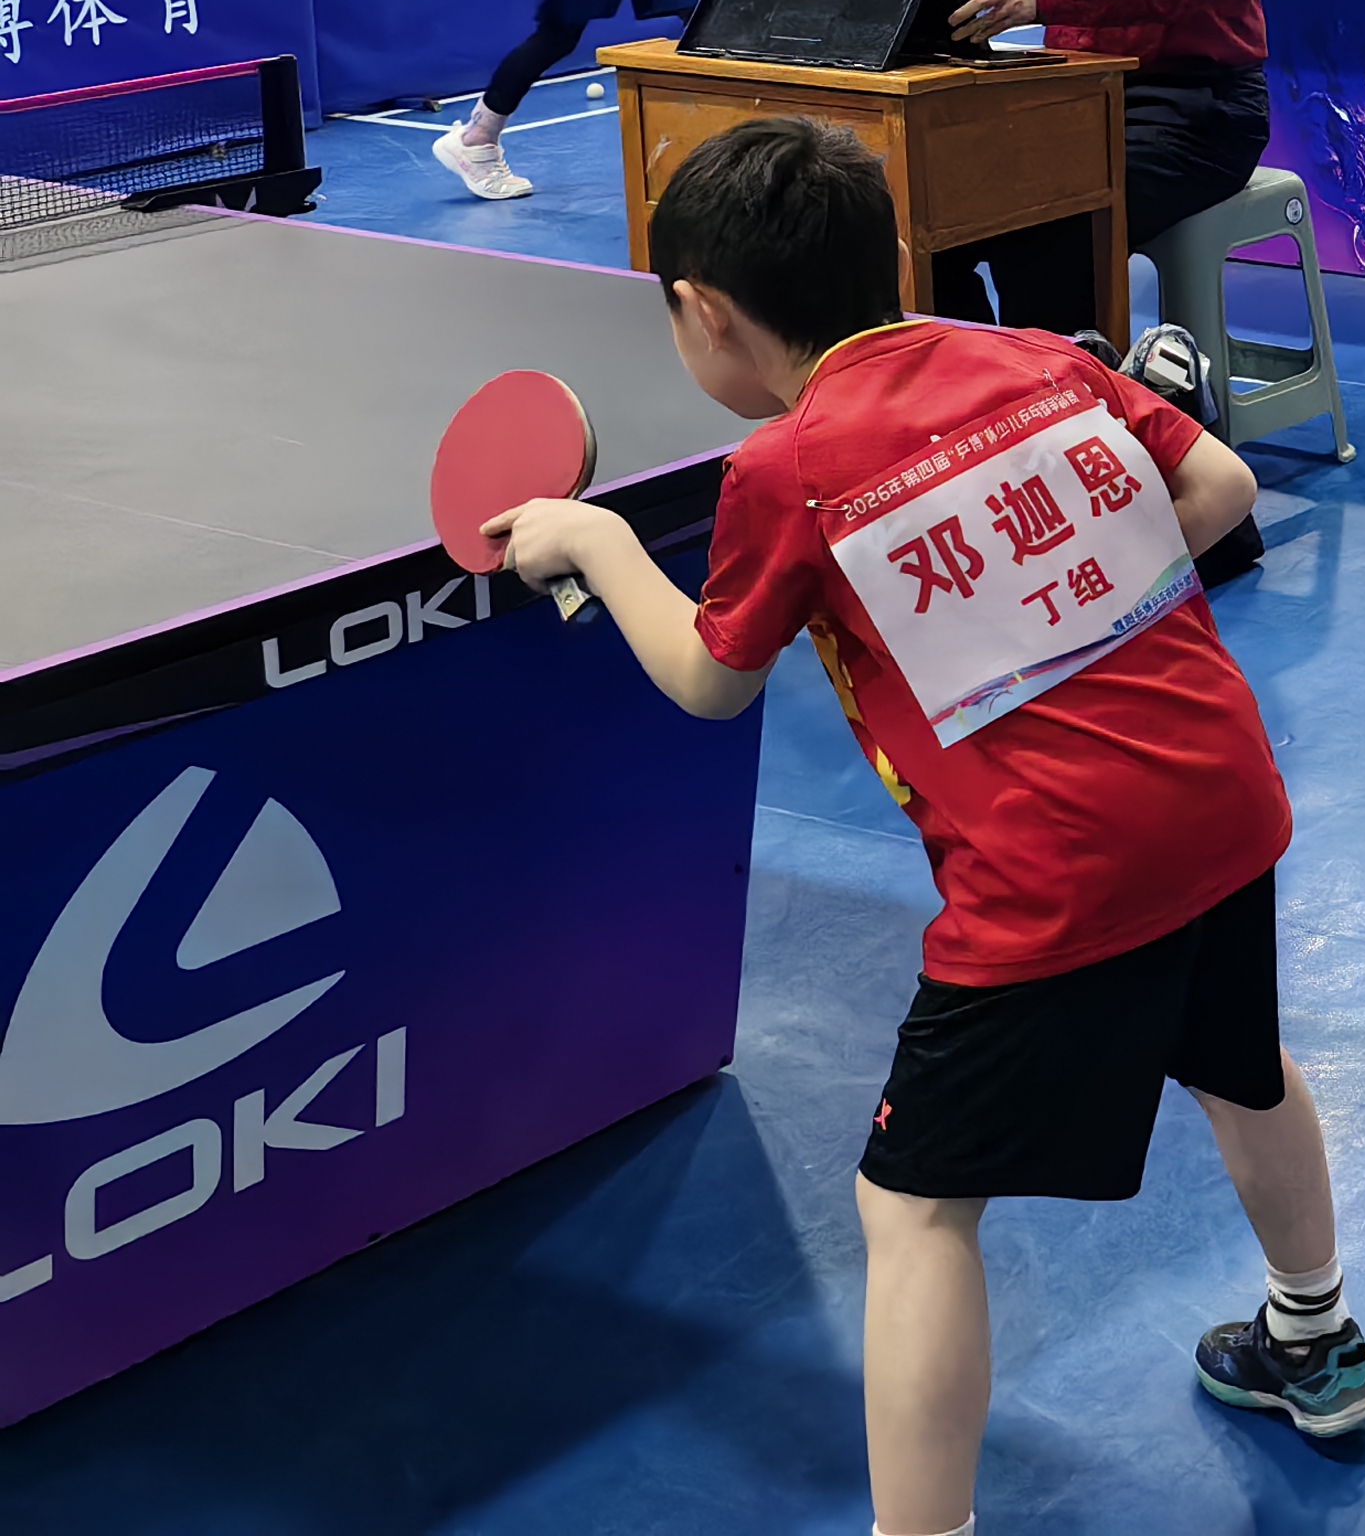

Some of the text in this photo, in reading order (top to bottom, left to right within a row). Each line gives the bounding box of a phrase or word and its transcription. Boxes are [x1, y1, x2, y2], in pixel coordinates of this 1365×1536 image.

[887, 435, 1143, 614] 邓迦恩
[262, 573, 491, 689] LOKI
[1021, 557, 1115, 626] 丁组
